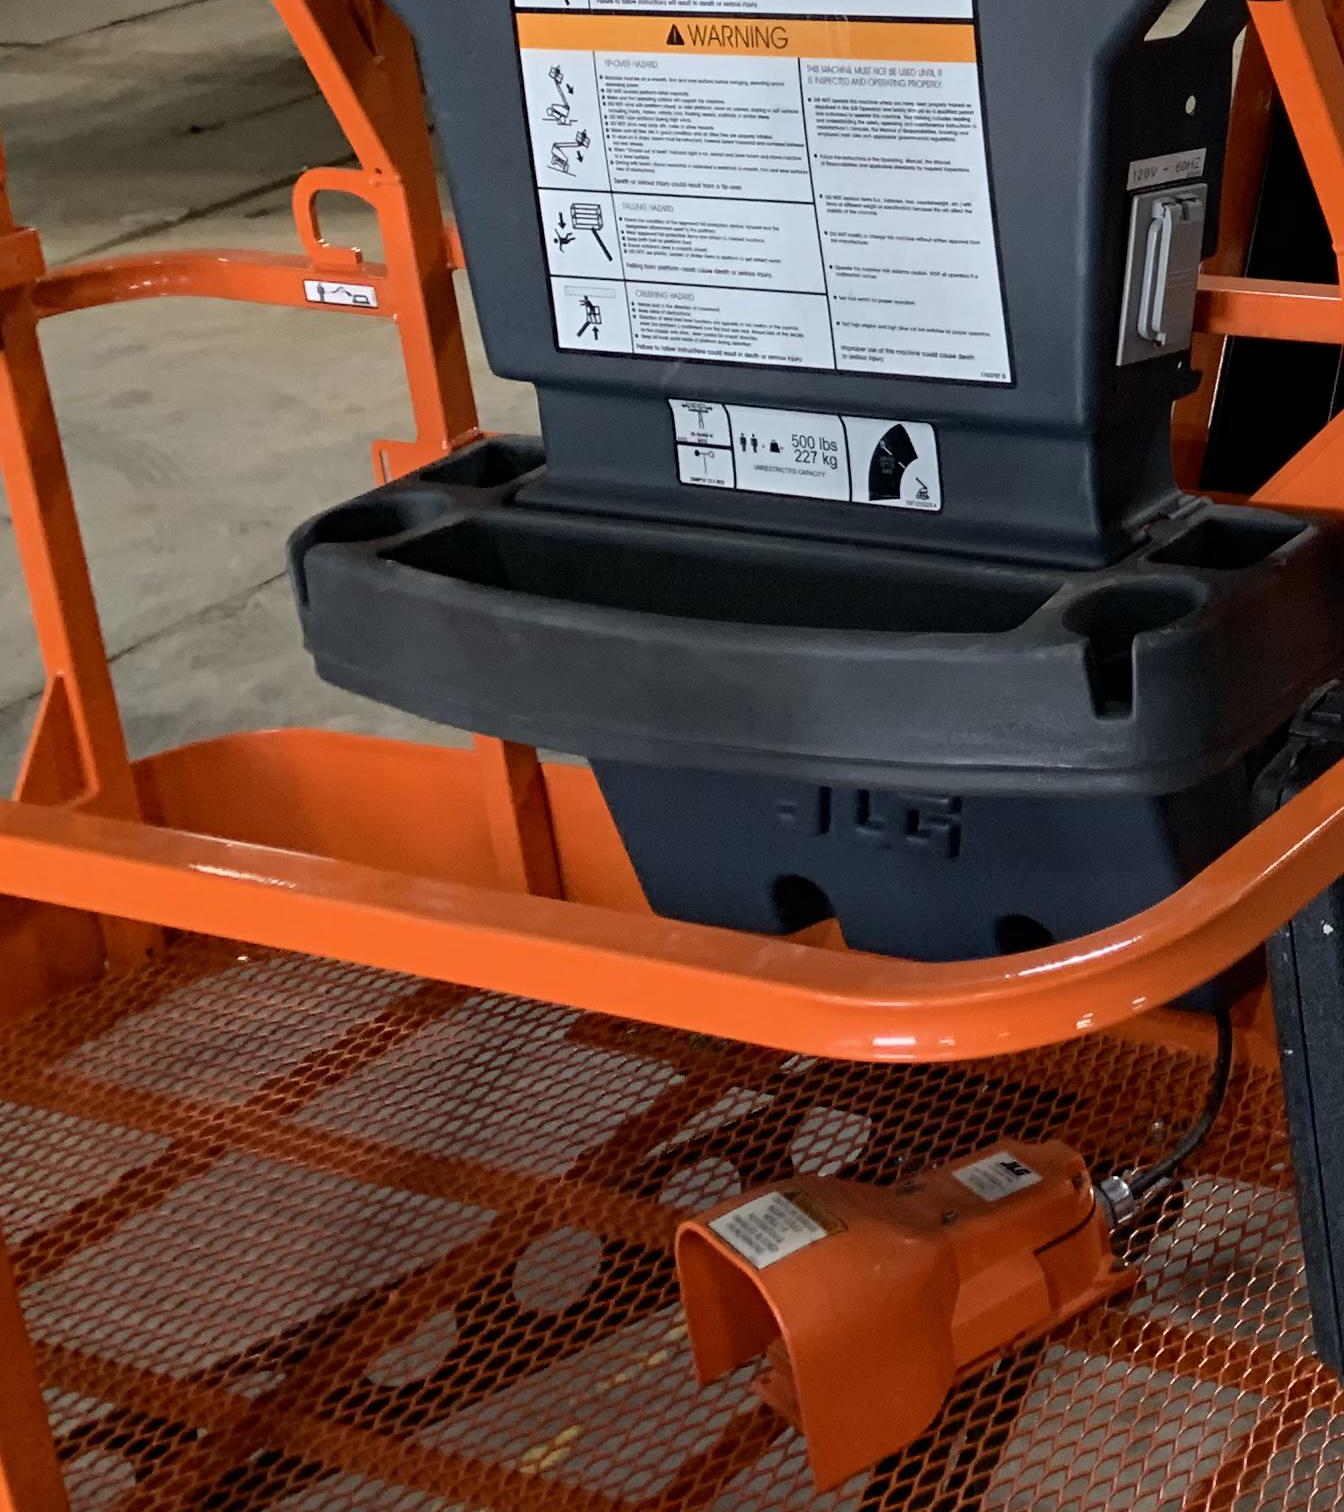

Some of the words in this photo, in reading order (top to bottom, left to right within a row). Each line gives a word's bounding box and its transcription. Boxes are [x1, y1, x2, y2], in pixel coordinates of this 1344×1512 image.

[687, 24, 789, 49] WARNING
[791, 434, 815, 450] 500
[819, 436, 838, 451] lbs
[794, 449, 817, 465] 227
[822, 451, 838, 470] kg
[753, 464, 797, 475] UNRESTRICTED
[798, 468, 826, 478] CAPACITY
